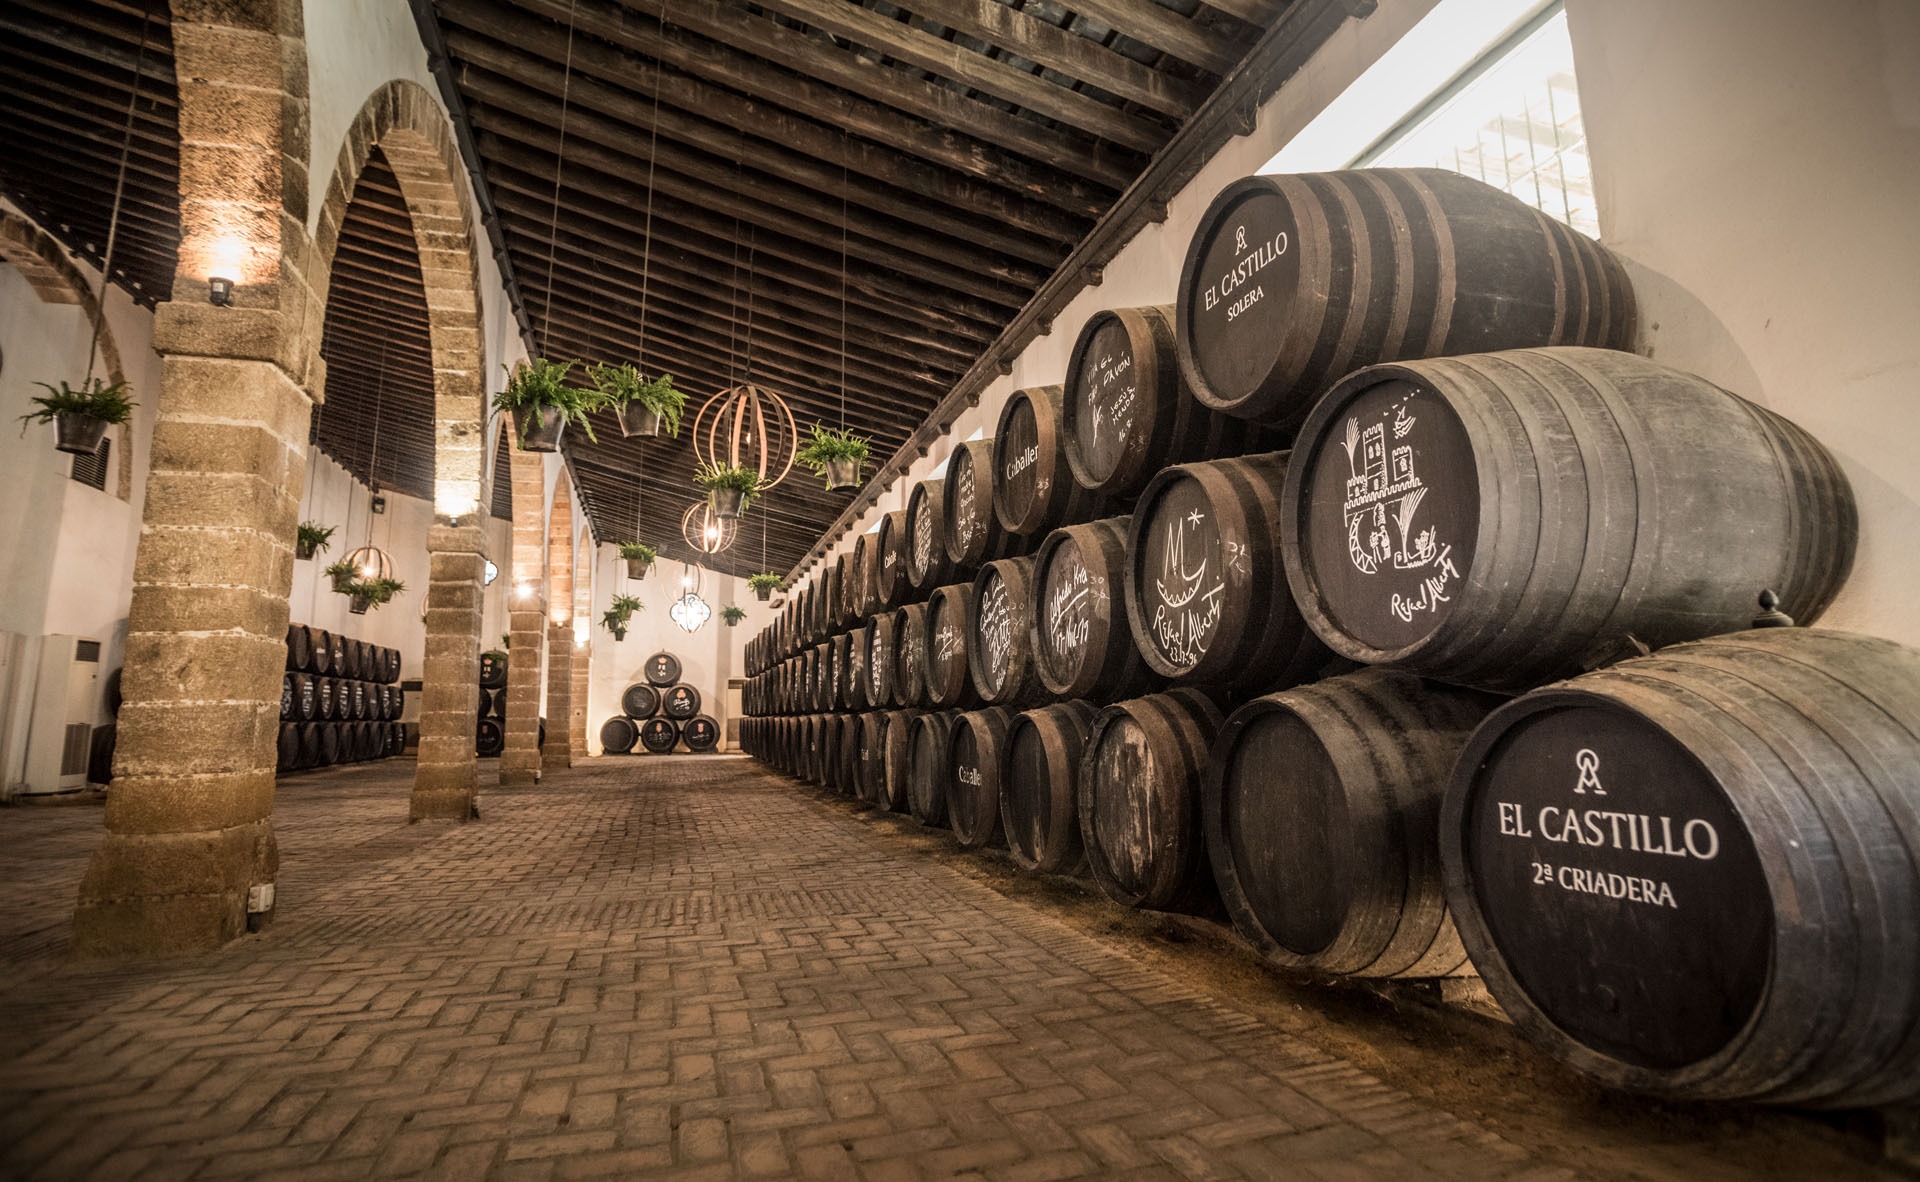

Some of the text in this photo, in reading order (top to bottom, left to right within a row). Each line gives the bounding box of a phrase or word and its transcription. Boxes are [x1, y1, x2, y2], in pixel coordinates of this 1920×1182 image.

[1204, 231, 1288, 311] EL CASTILLO
[1227, 285, 1264, 322] SOLERA
[1391, 583, 1428, 623] Rafael
[1153, 604, 1185, 660] Rafael
[1498, 802, 1720, 861] EL CASTILLO
[1531, 861, 1678, 910] 2ª CRIADERA
